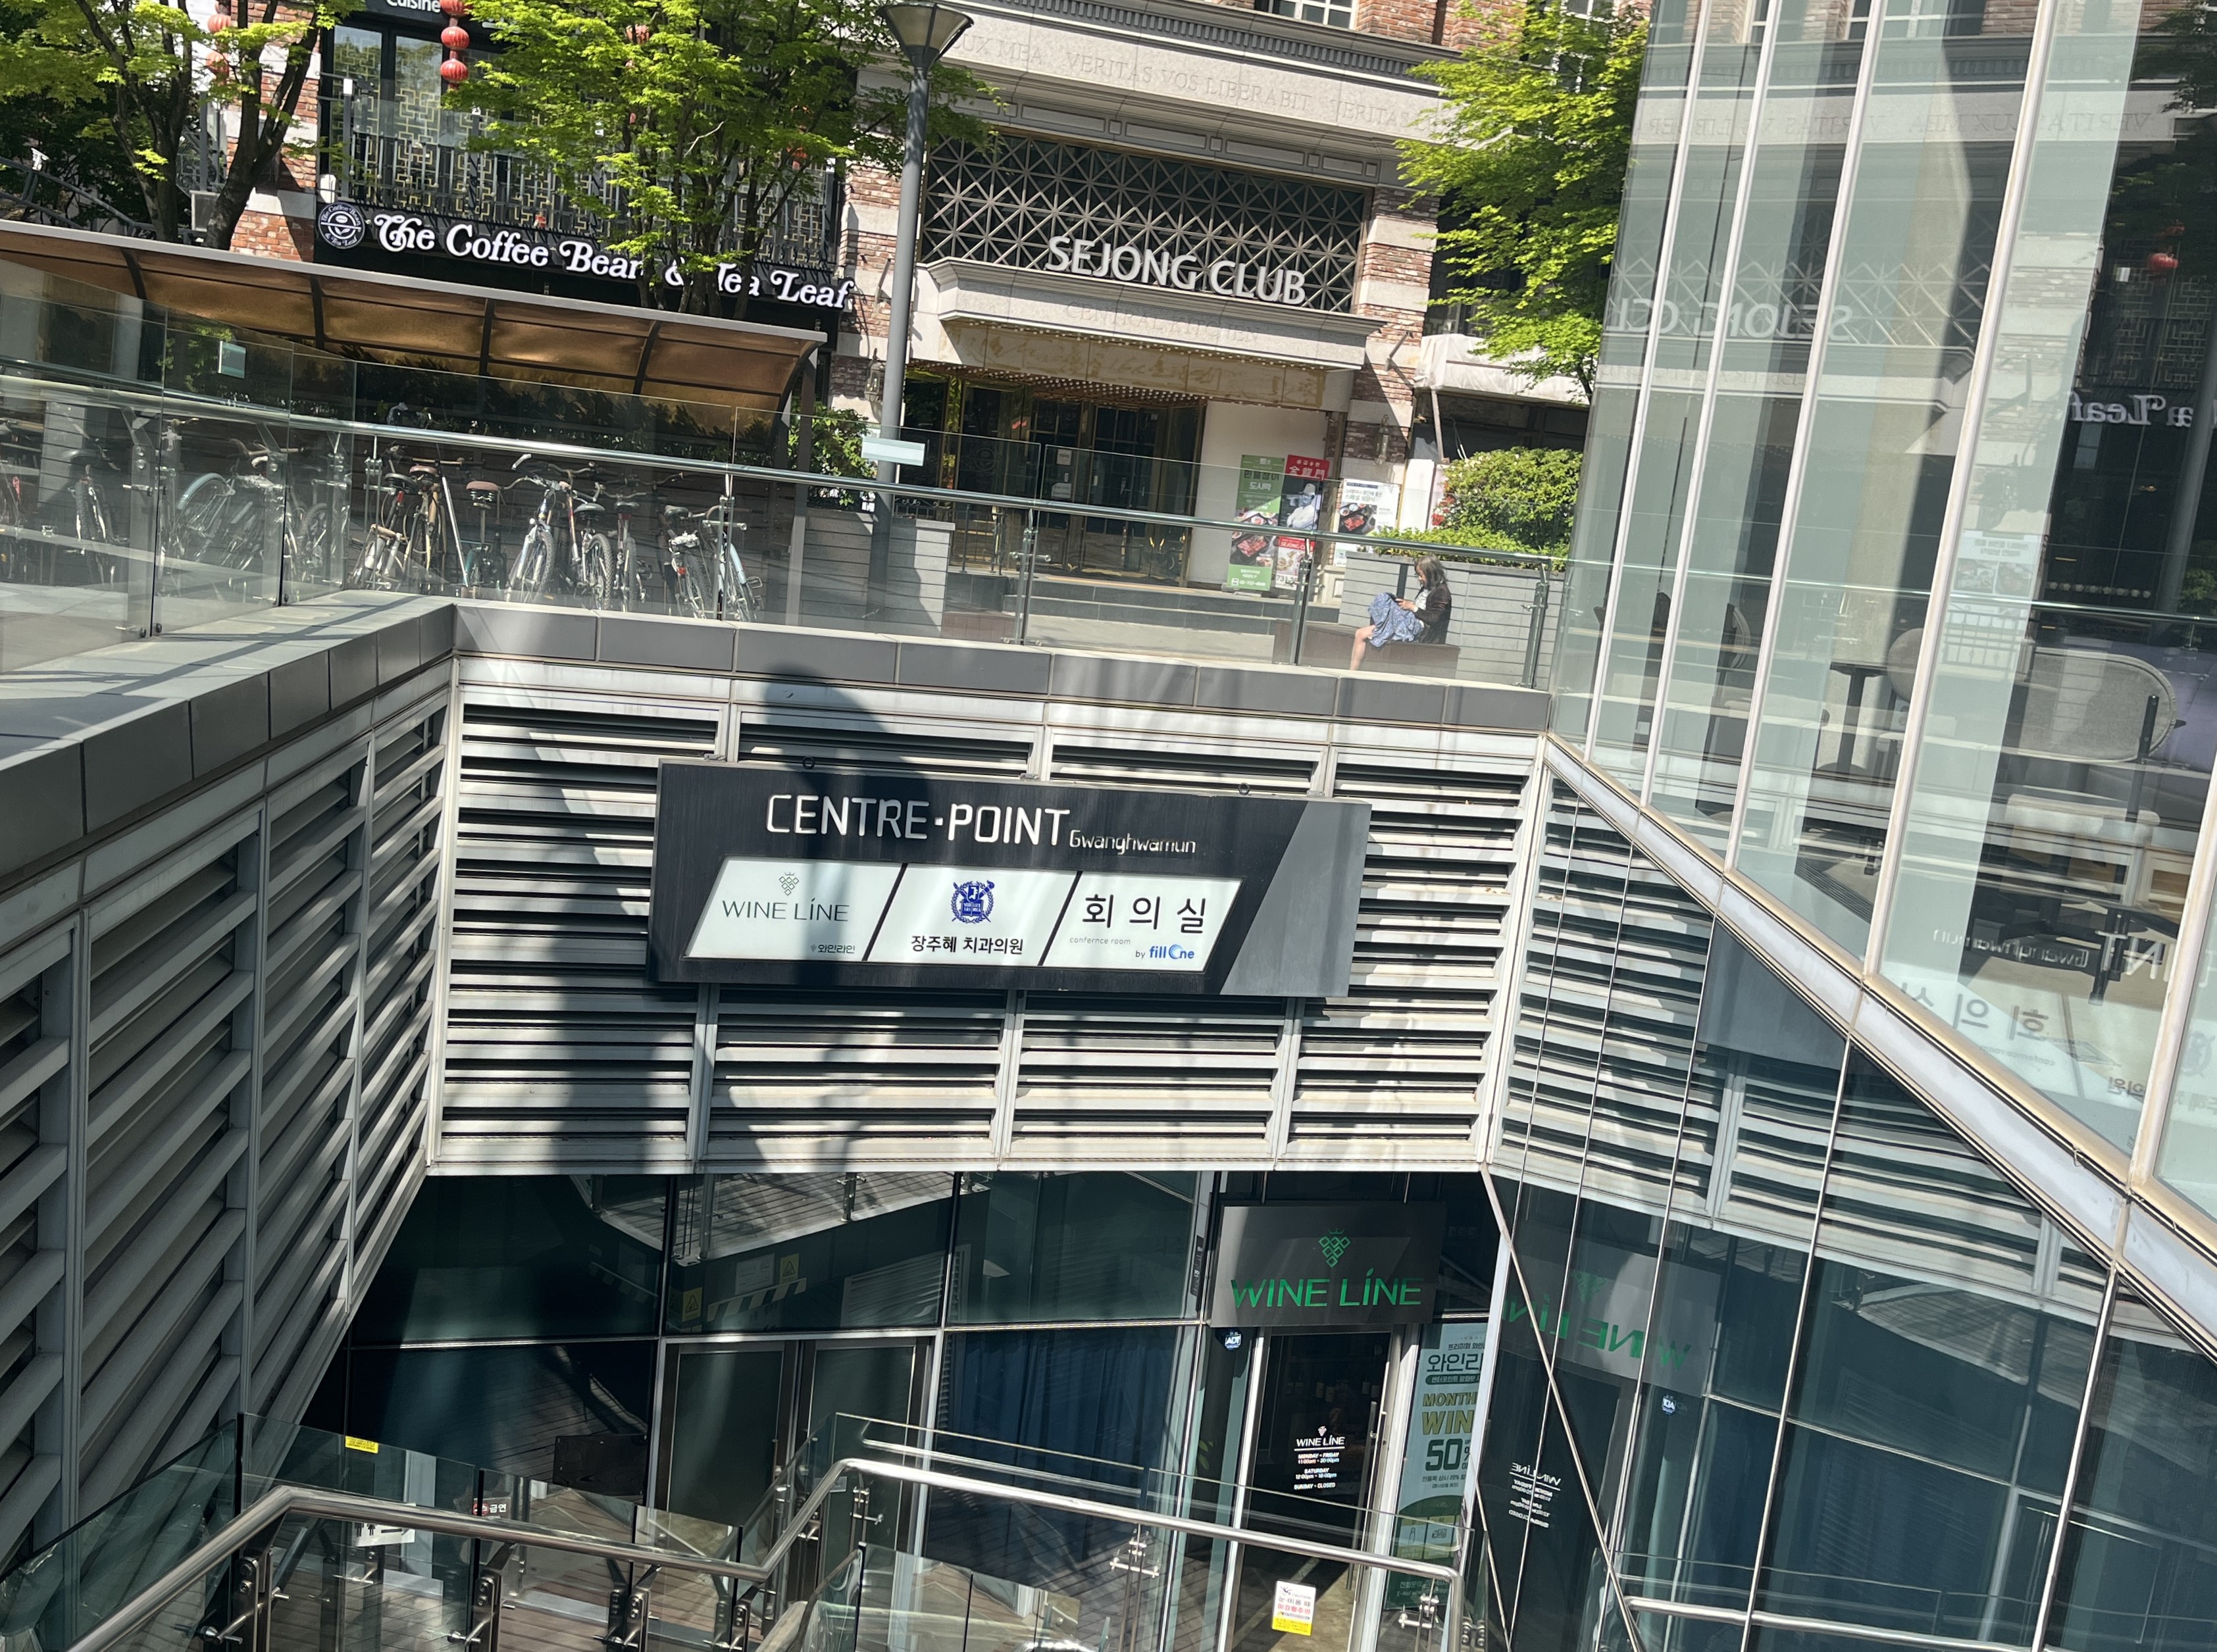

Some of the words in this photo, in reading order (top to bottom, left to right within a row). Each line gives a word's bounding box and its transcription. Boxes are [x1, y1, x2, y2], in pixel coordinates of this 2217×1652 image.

[1065, 52, 1154, 83] VERITAS
[1161, 69, 1200, 92] VOS
[1205, 77, 1313, 111] LIBERABIT
[1331, 99, 1410, 128] VERITAS
[373, 213, 436, 253] The
[446, 223, 549, 267] Coffee
[770, 269, 855, 309] Leaf
[1044, 235, 1197, 290] SEJONG
[1209, 260, 1306, 305] CLUB
[1069, 829, 1197, 855] Gwanghwamun
[722, 899, 788, 920] WINE
[817, 944, 855, 954] 와인라인
[911, 935, 957, 953] 장주혜
[963, 937, 1024, 955] 치과의원
[1135, 950, 1146, 960] by
[1231, 1278, 1331, 1309] WINE
[1225, 1336, 1242, 1345] ADT
[1296, 1438, 1322, 1447] WINE
[489, 1503, 507, 1513] 금연
